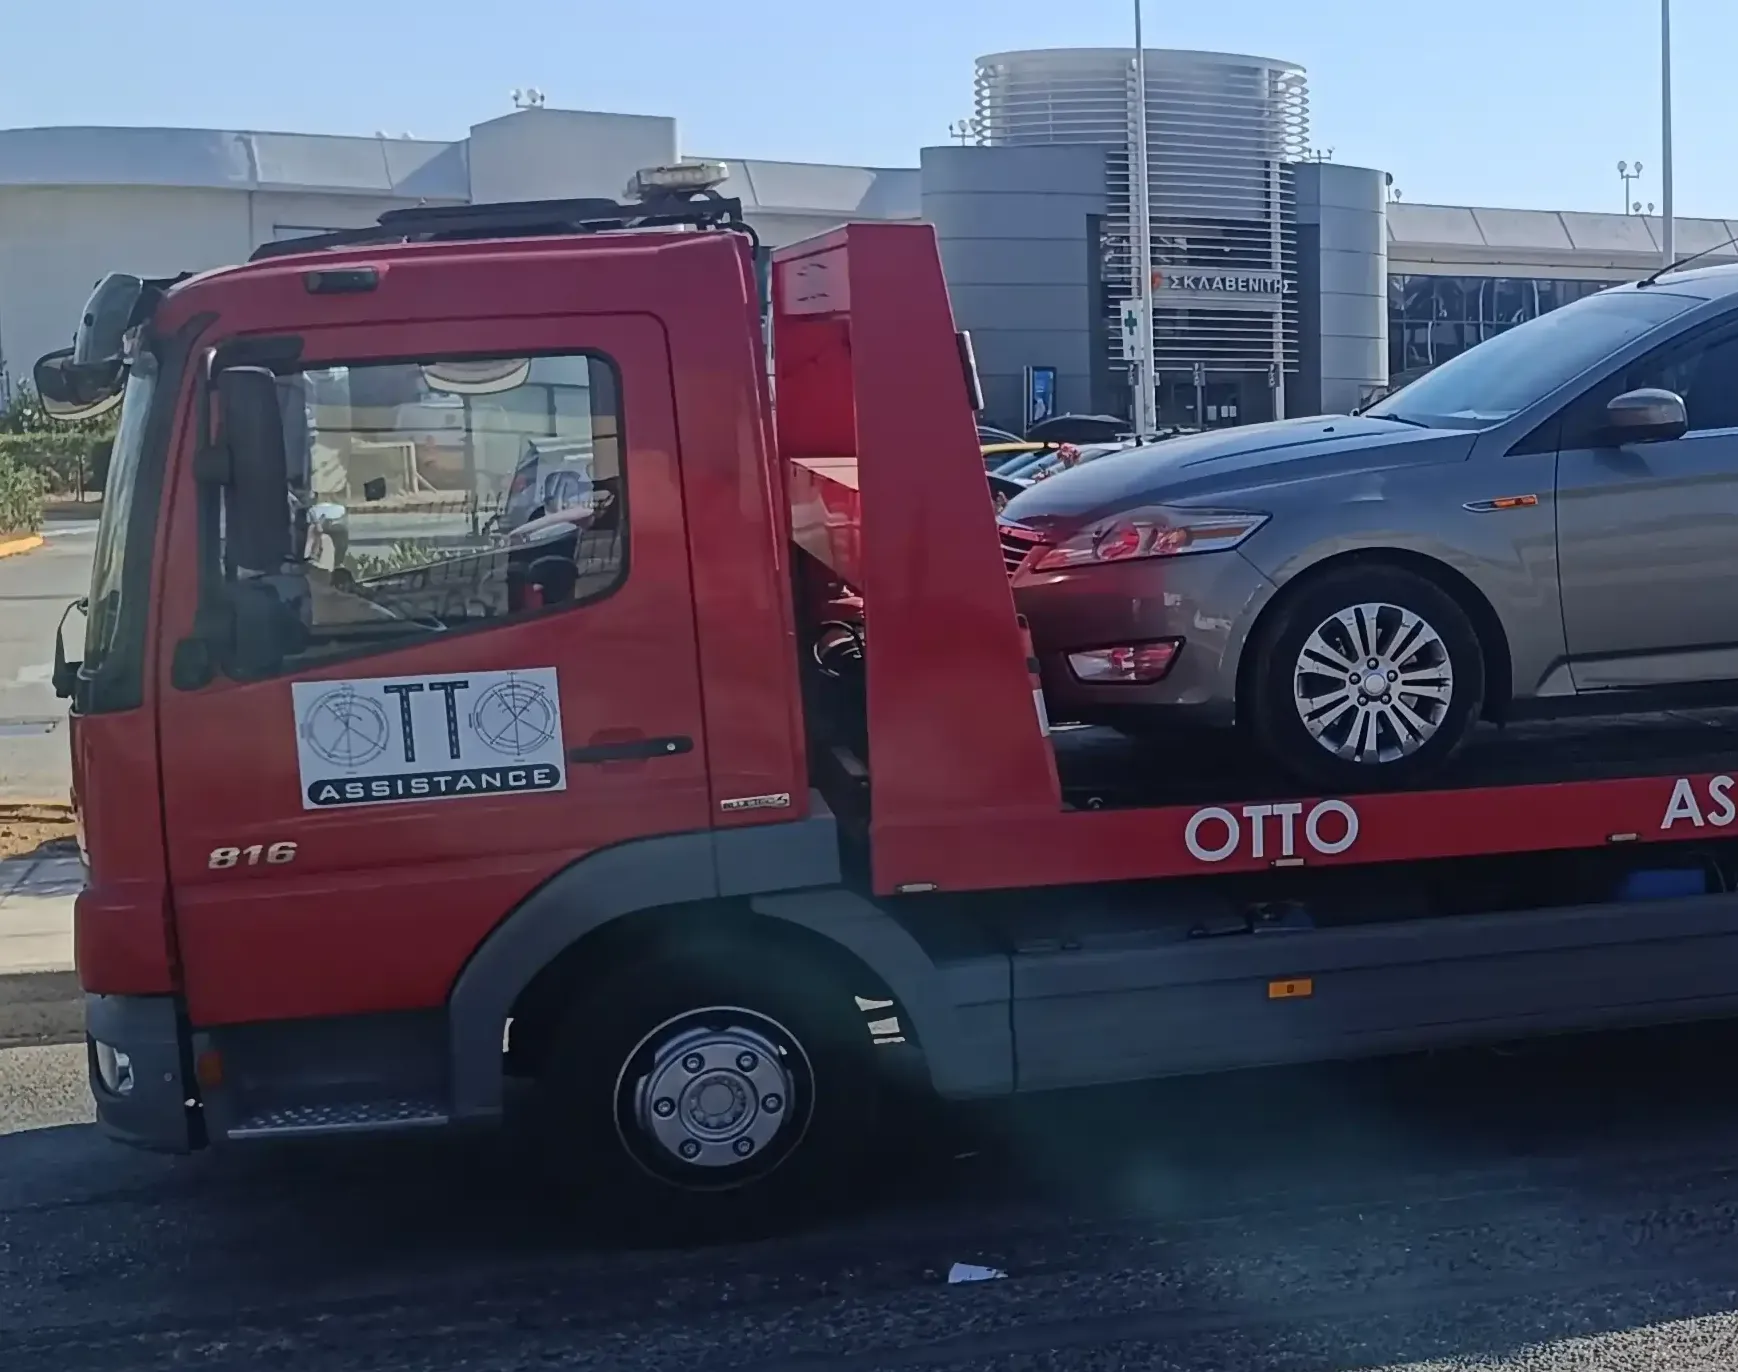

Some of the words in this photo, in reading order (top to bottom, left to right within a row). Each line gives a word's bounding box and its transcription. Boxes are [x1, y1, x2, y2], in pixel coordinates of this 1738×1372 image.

[1170, 275, 1298, 294] ΣΚΛΑΒΕΝΙΤΗΣ
[319, 768, 551, 801] ASSISTANCE
[1184, 799, 1359, 862] OTTO
[208, 841, 298, 870] 816
